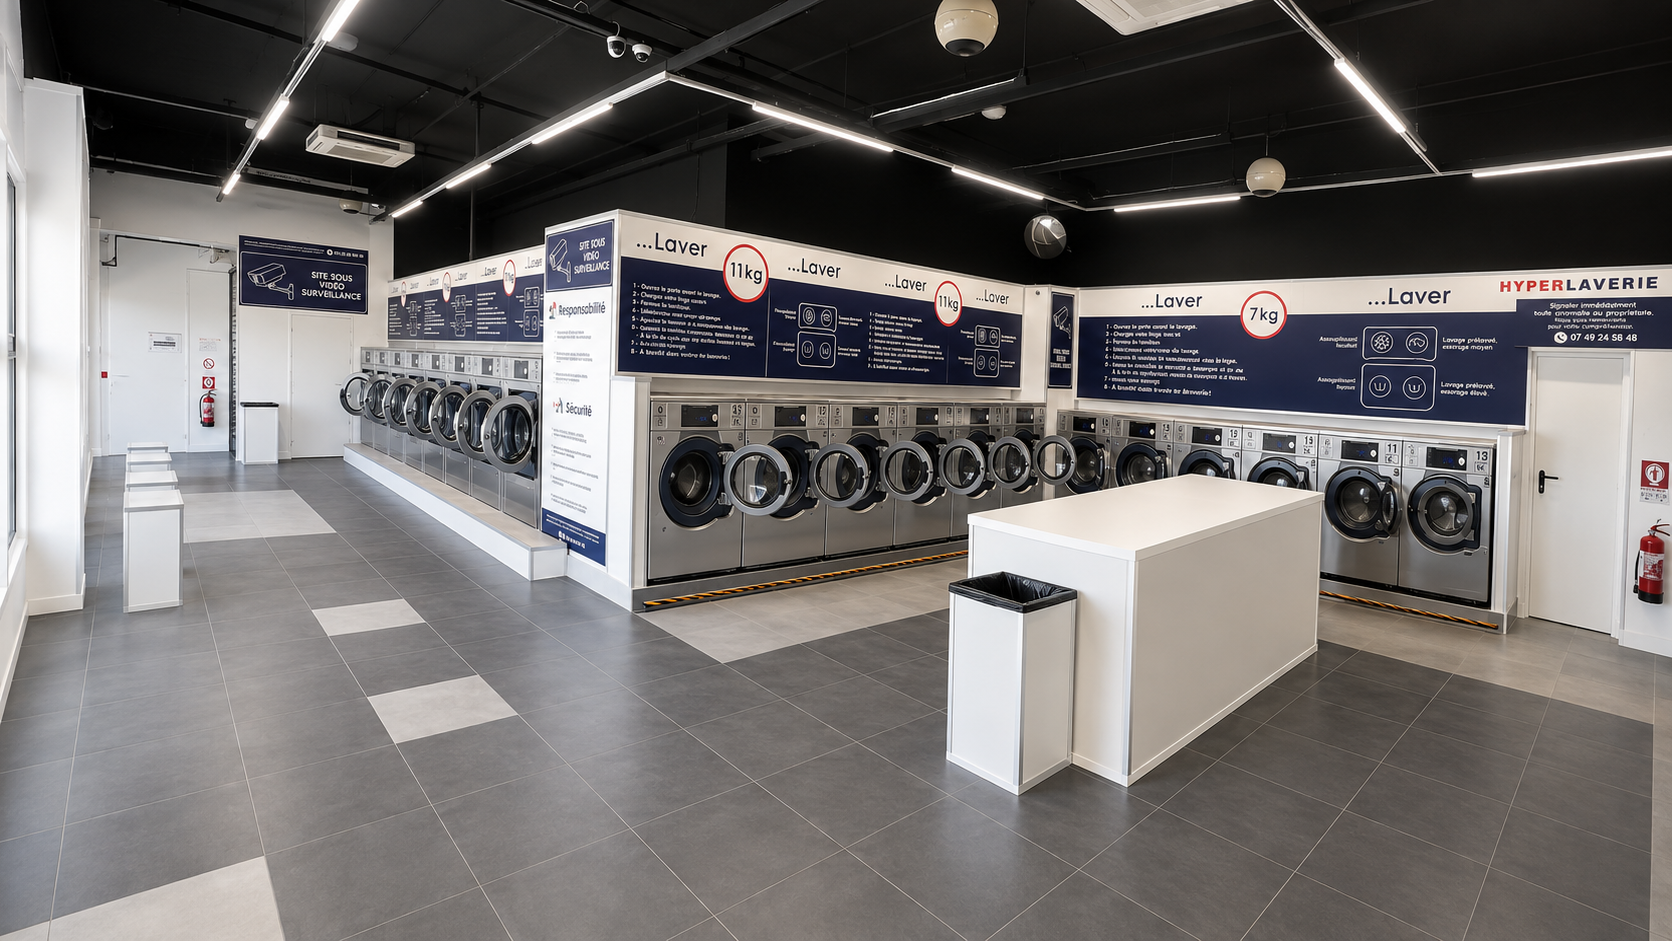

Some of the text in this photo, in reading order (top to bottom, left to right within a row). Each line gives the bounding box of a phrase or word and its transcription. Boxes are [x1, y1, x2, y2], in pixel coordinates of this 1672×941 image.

[636, 232, 708, 257] ...Laver
[730, 262, 764, 284] 11kg
[787, 258, 841, 278] ...Laver
[311, 271, 353, 282] SITE SOUS
[884, 274, 927, 292] ...Laver
[1500, 276, 1659, 292] HYPERLAVERIE
[301, 288, 362, 301] SURVEILLANCE
[1141, 294, 1203, 309] ...Laver
[1368, 288, 1451, 306] ...Laver
[938, 295, 959, 312] 11kg
[1249, 307, 1279, 324] 7kg
[1570, 333, 1581, 342] 07
[1597, 333, 1609, 342] 24
[566, 402, 592, 418] Sécurité
[1476, 451, 1488, 461] 13
